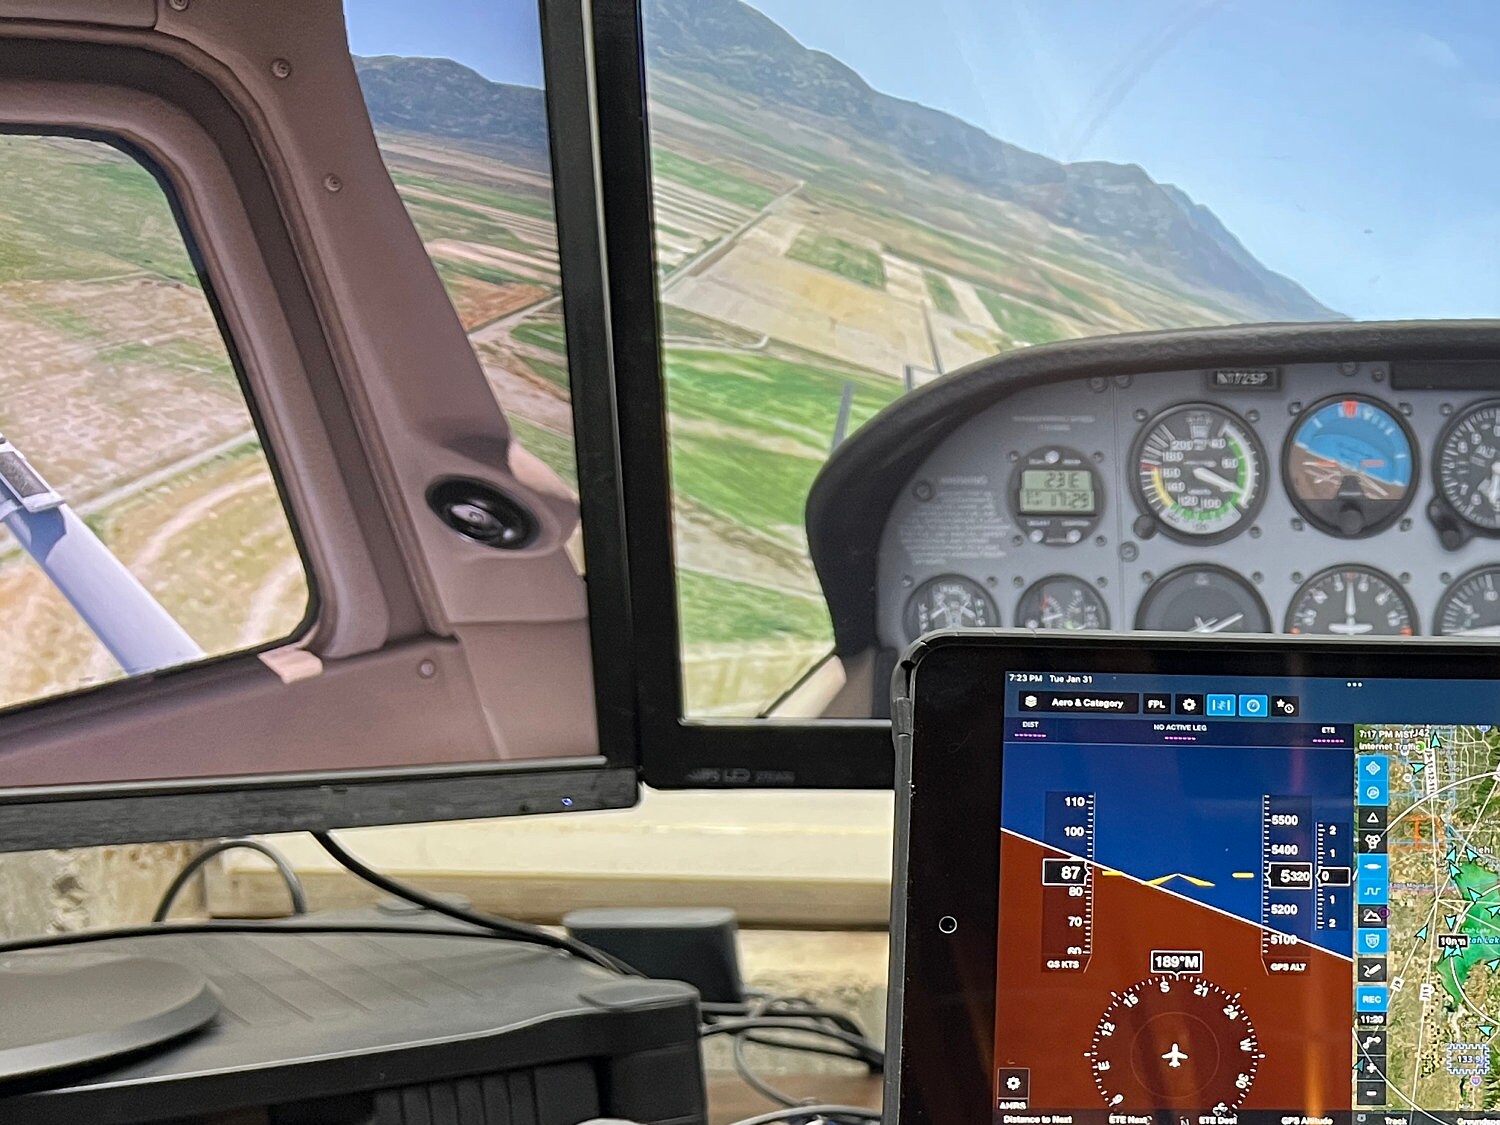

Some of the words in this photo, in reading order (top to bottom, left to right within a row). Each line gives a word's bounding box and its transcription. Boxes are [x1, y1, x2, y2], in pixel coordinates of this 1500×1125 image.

[1009, 674, 1027, 682] 7:23
[1029, 674, 1043, 682] PM
[1050, 675, 1064, 683] Tue
[1066, 675, 1081, 683] Jan
[1052, 698, 1072, 707] Aero
[1083, 698, 1124, 709] Category
[1148, 700, 1166, 709] FPL
[1166, 724, 1191, 732] ACTIVE
[1359, 730, 1379, 738] 7:17
[1380, 730, 1393, 738] PM
[1359, 743, 1393, 751] Internet
[1395, 743, 1419, 751] Traffic
[1065, 797, 1085, 807] 110
[1271, 815, 1298, 826] 5500
[1064, 827, 1084, 837] 100
[1329, 826, 1337, 835] 2
[1271, 844, 1298, 855] 5400
[1061, 866, 1081, 880] 87
[1280, 869, 1311, 883] 5320
[1322, 871, 1329, 881] 0
[1069, 887, 1083, 897] 80
[1271, 904, 1298, 915] 5200
[1068, 917, 1083, 927] 70
[1329, 919, 1337, 928] 2
[1270, 934, 1297, 945] 5100
[1047, 960, 1059, 969] GS
[1061, 960, 1080, 969] KTS
[1155, 955, 1198, 968] 189°M
[1270, 963, 1287, 972] GPS
[1289, 963, 1306, 972] ALT
[1160, 981, 1170, 993] S
[1362, 995, 1382, 1004] REC
[1101, 1022, 1116, 1037] 12
[1003, 1116, 1041, 1124] Distance
[1041, 1116, 1051, 1124] to
[1052, 1116, 1073, 1124] Next
[1108, 1116, 1127, 1125] ETE
[1128, 1116, 1148, 1125] Next
[1199, 1116, 1217, 1125] ETE
[1281, 1117, 1300, 1125] GPS
[1301, 1117, 1333, 1125] Altitude
[1384, 1117, 1408, 1125] Track
